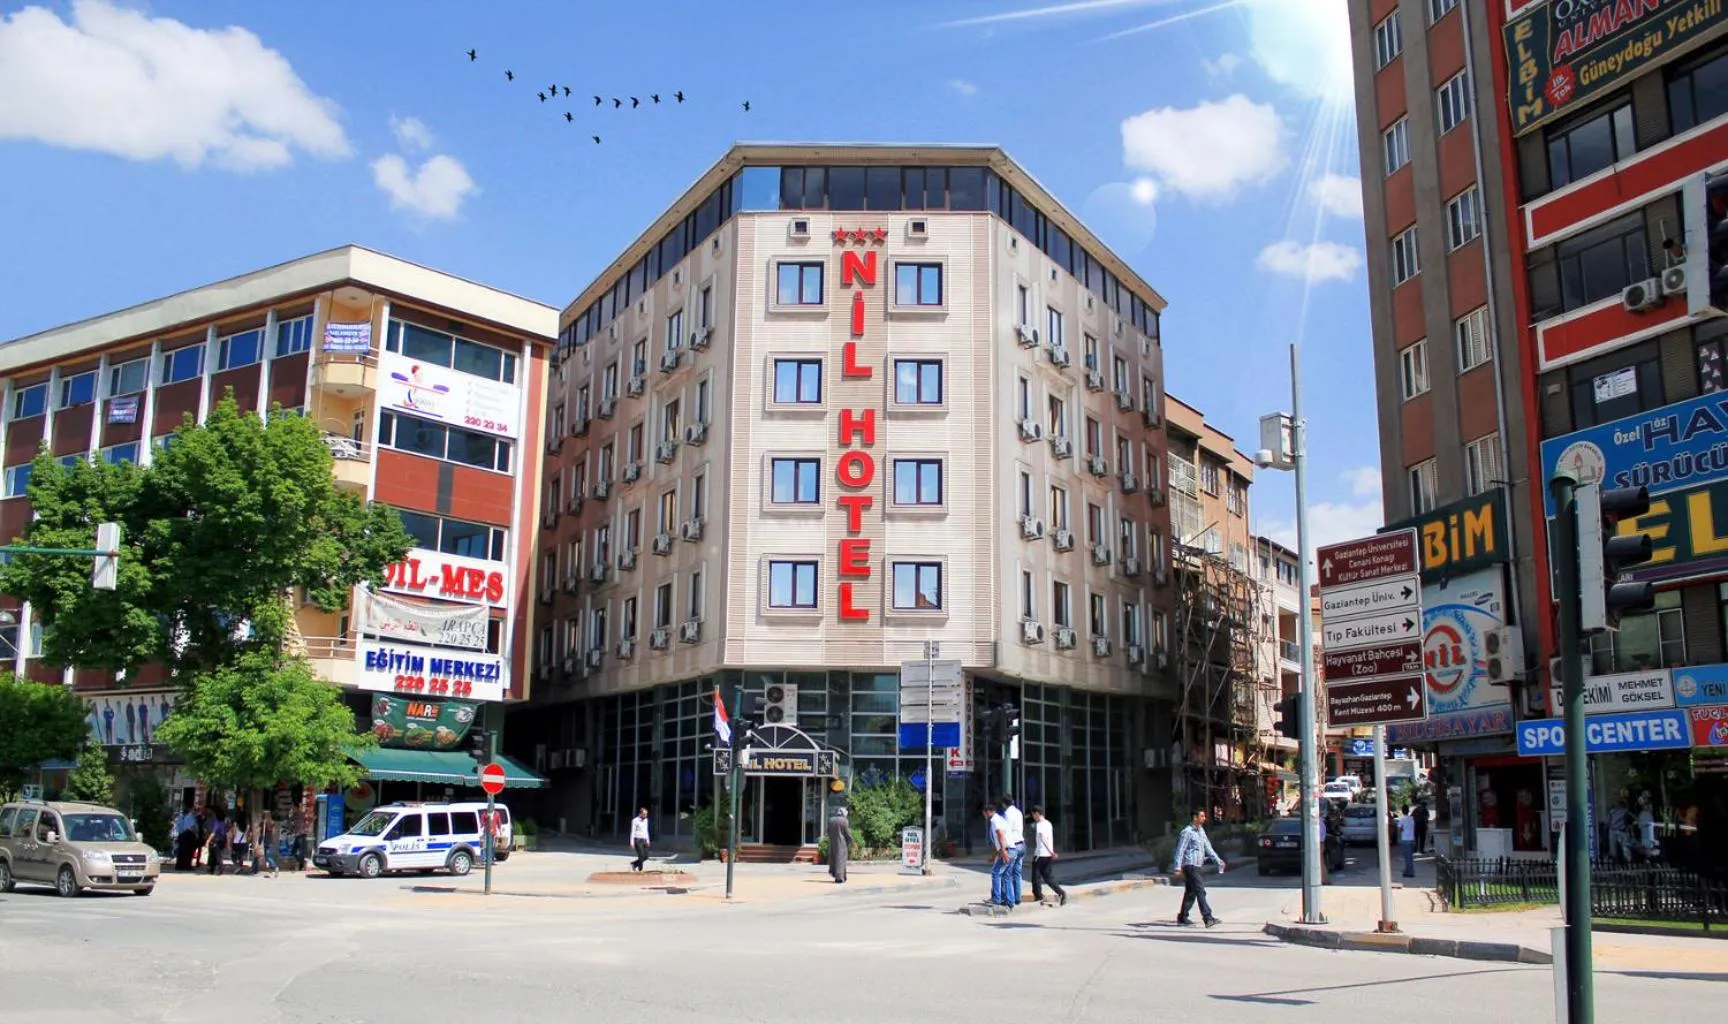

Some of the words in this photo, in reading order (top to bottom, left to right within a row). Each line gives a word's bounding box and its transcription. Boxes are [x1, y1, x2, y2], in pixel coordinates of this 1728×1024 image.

[1554, 0, 1669, 64] ALMAN
[1579, 30, 1663, 86] Güneydoğu
[840, 249, 878, 379] NİL
[464, 416, 480, 427] 220
[483, 419, 495, 430] 22
[1613, 426, 1641, 445] Özel
[1614, 442, 1728, 489] SÜRÜCÜ
[836, 408, 876, 621] HOTEL
[1422, 503, 1495, 570] BİM
[1334, 546, 1367, 561] Gaziantep
[1368, 538, 1409, 553] Üniversitesi
[1338, 569, 1359, 582] Kültür
[1360, 566, 1380, 578] Sanat
[1381, 562, 1408, 575] Merkezi
[1324, 594, 1370, 610] Gaziantep
[1372, 591, 1396, 603] Üniv.
[459, 634, 472, 646] 25
[473, 636, 486, 648] 25
[1327, 630, 1343, 643] Tıp
[1345, 621, 1397, 639] Fakültesi
[365, 648, 425, 676] EĞİTİM
[429, 658, 501, 684] MERKEZİ
[1326, 652, 1367, 667] Hayvanat
[1367, 647, 1404, 661] Bahçesi
[1351, 661, 1378, 676] (Zoo)
[394, 674, 425, 692] 220
[429, 679, 449, 696] 25
[452, 681, 473, 698] 25
[1583, 682, 1613, 705] EKİMİ
[1618, 677, 1664, 690] MEHMET
[1621, 690, 1665, 703] GÖKSEL
[1334, 708, 1350, 717] Kent
[1350, 705, 1375, 715] Müzesi
[1377, 703, 1392, 713] 400
[1524, 725, 1565, 748] SPO
[1587, 717, 1683, 745] CENTER
[763, 757, 812, 771] HOTEL
